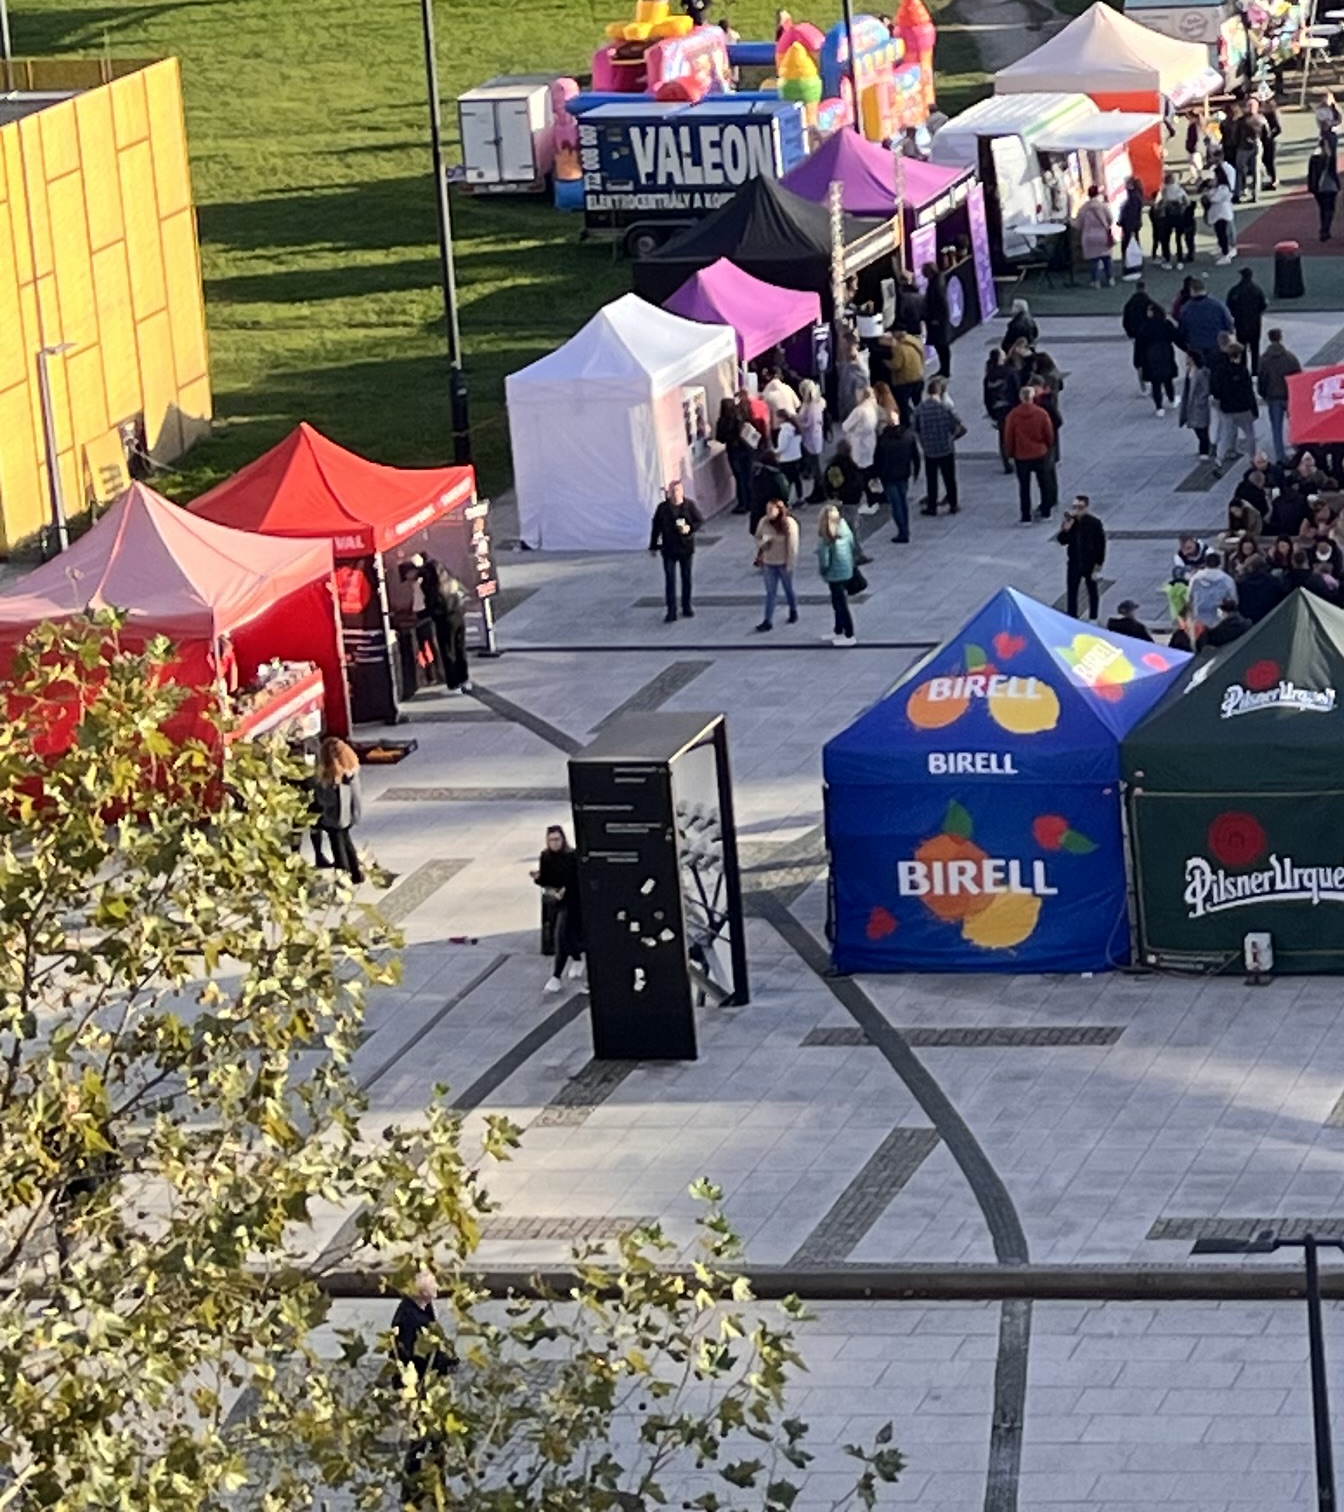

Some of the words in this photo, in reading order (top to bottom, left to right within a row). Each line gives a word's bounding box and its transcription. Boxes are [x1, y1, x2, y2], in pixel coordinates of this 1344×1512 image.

[629, 124, 774, 185] VALEON
[927, 674, 1043, 702] BIRELL
[1220, 685, 1281, 721] Pilsner
[928, 752, 1018, 775] BIRELL
[897, 858, 1059, 896] BIRELL
[1184, 856, 1275, 919] Pilsner
